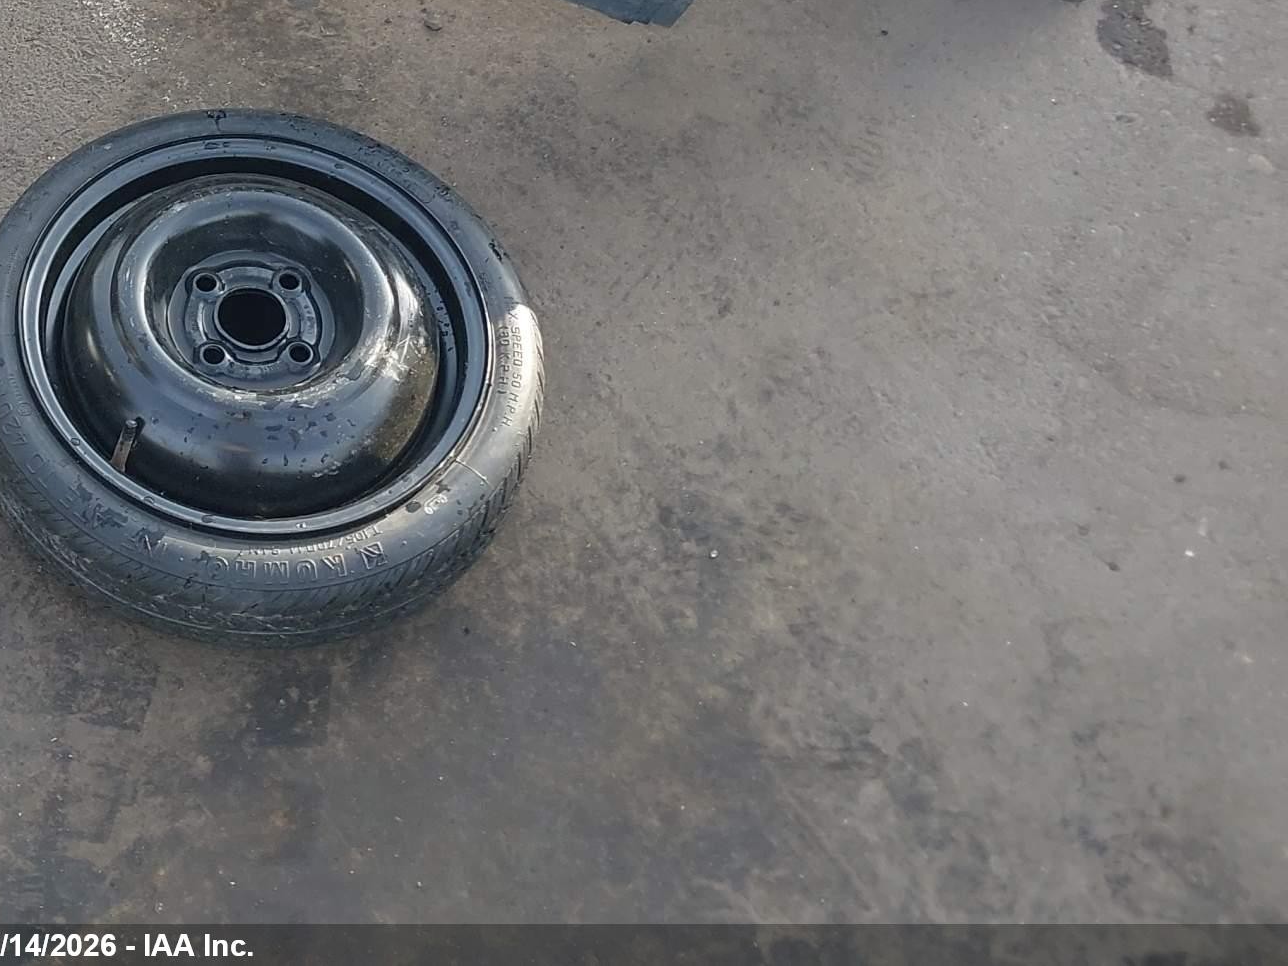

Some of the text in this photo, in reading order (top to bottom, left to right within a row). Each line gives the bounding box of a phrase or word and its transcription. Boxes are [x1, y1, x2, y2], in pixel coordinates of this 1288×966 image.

[510, 326, 522, 367] SPEED
[511, 373, 522, 388] 50
[209, 553, 347, 584] KUMHO
